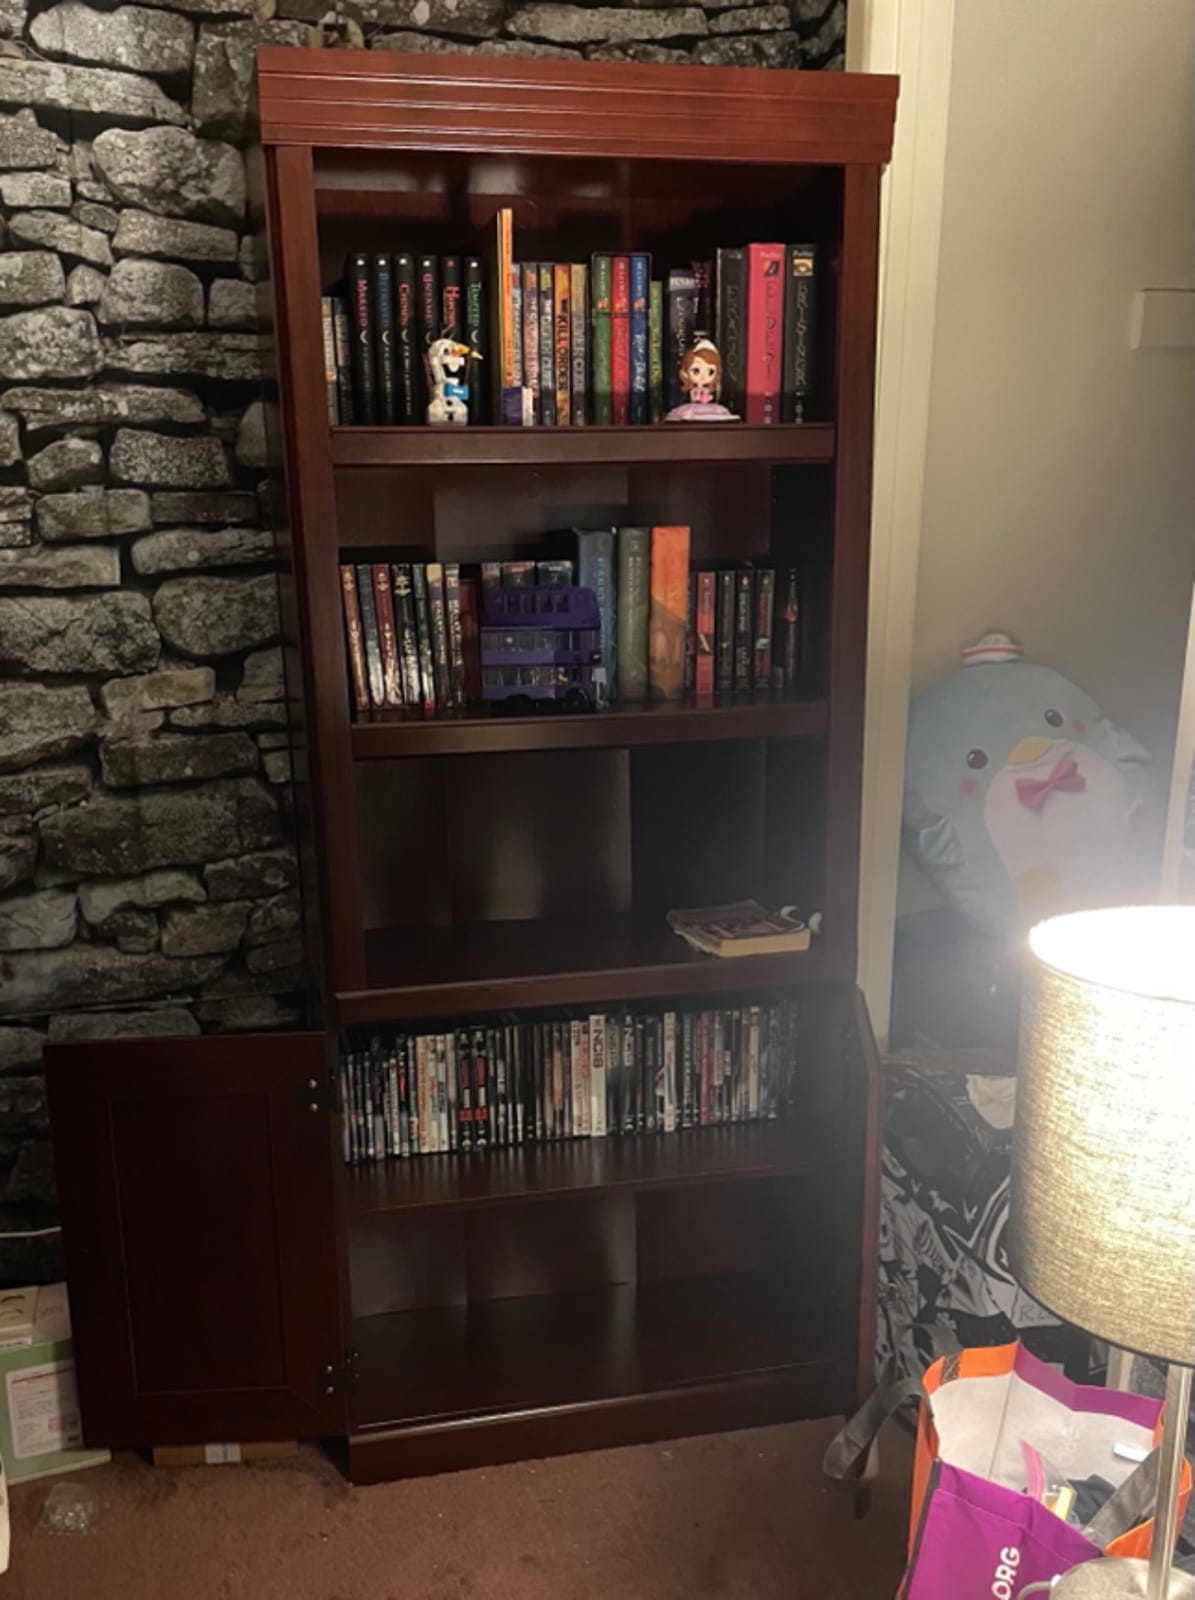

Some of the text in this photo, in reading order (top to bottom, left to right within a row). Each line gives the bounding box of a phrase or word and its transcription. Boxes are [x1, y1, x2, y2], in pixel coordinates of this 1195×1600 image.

[558, 315, 569, 344] KILL
[558, 345, 569, 391] ORDER
[593, 1028, 604, 1069] NCIS
[990, 1546, 1021, 1600] ORG
